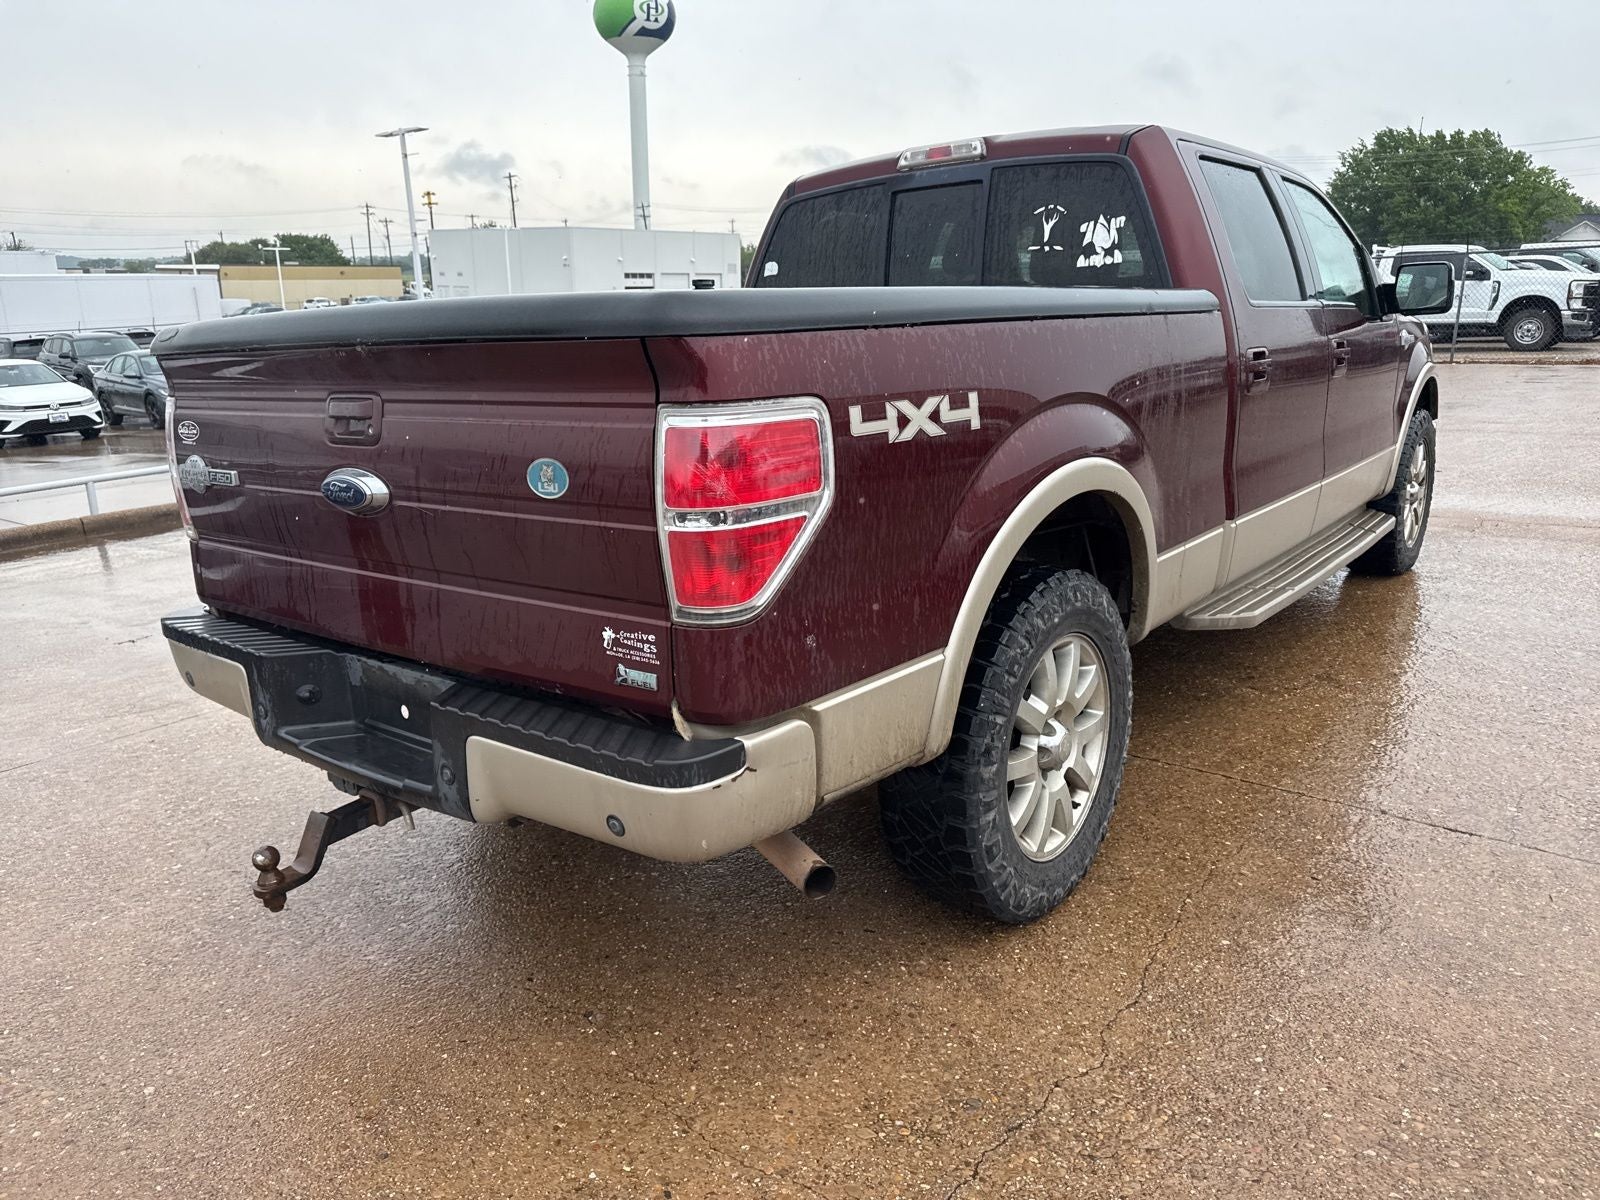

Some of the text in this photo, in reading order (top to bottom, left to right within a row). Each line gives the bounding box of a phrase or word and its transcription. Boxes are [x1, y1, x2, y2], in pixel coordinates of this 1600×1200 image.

[209, 472, 231, 483] F-150
[328, 481, 355, 502] Ford
[620, 630, 656, 642] Creative
[620, 636, 657, 653] Coatings
[630, 679, 655, 690] FUEL
